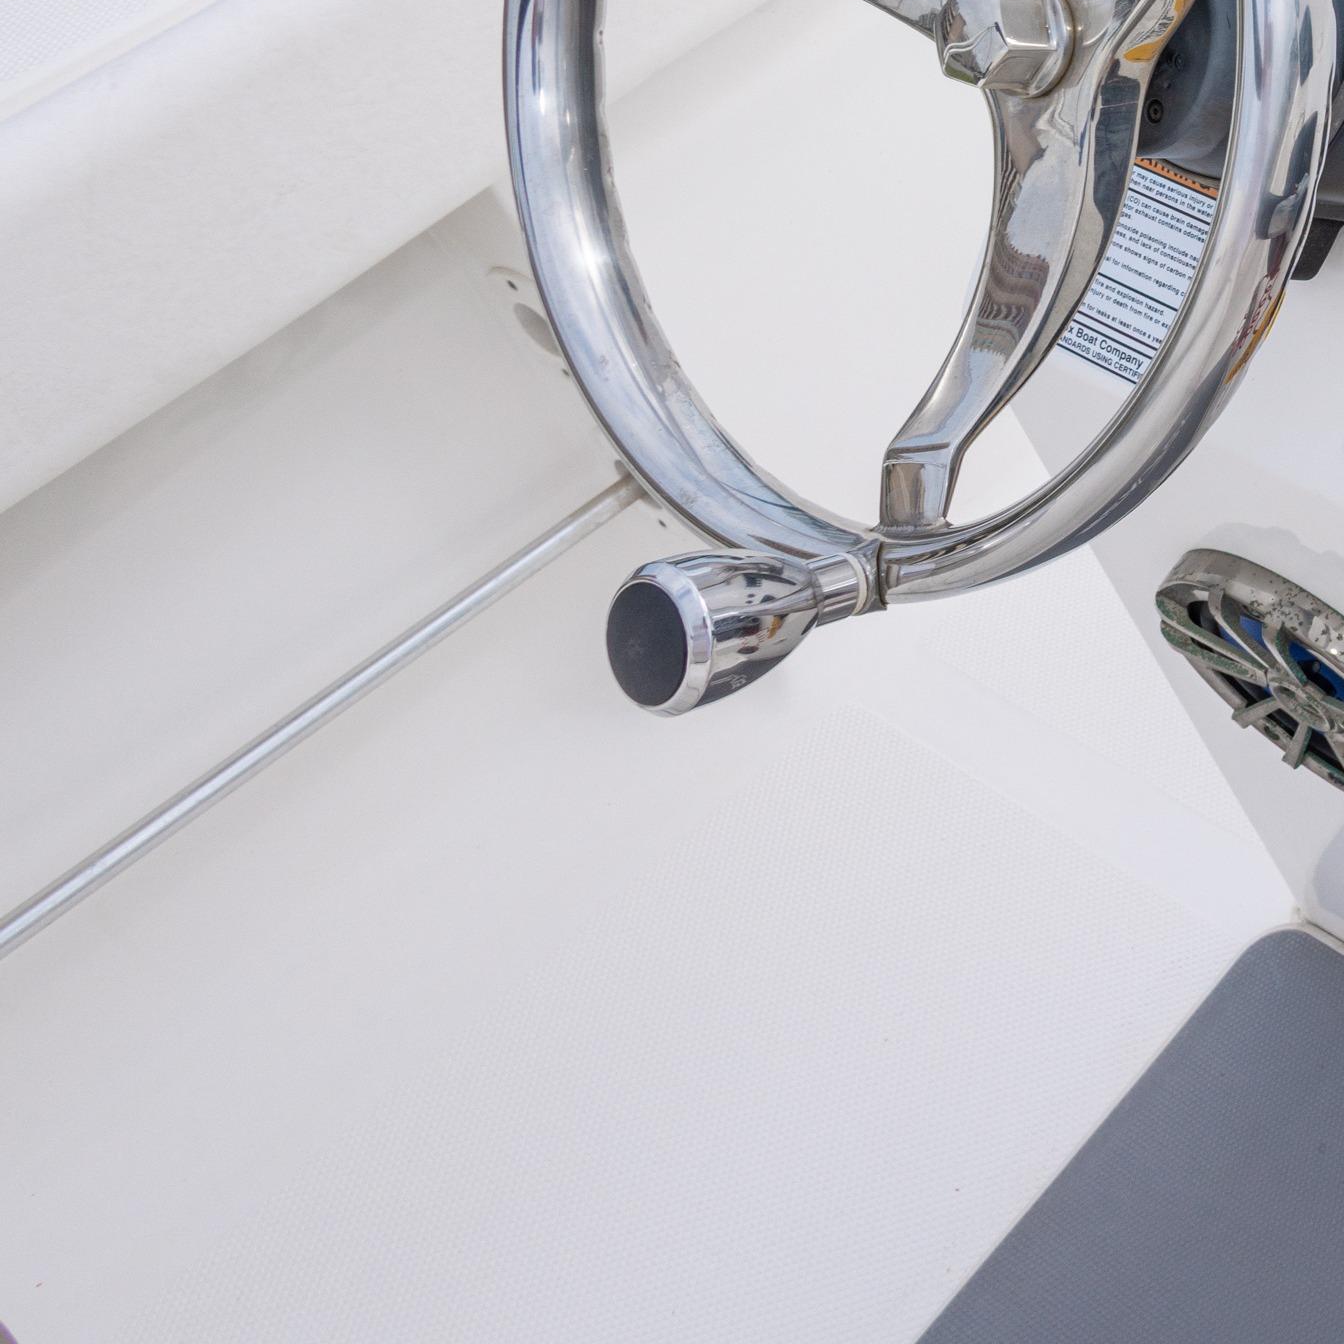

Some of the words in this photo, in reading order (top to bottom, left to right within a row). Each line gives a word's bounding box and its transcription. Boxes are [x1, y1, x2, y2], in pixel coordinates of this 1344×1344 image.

[1148, 177, 1166, 189] cause
[1166, 185, 1188, 199] serious
[1187, 195, 1205, 207] injury
[1154, 189, 1179, 203] persons
[1152, 207, 1169, 218] cause
[1169, 214, 1186, 225] brain
[1074, 327, 1099, 346] Boat
[1096, 338, 1145, 370] Company
